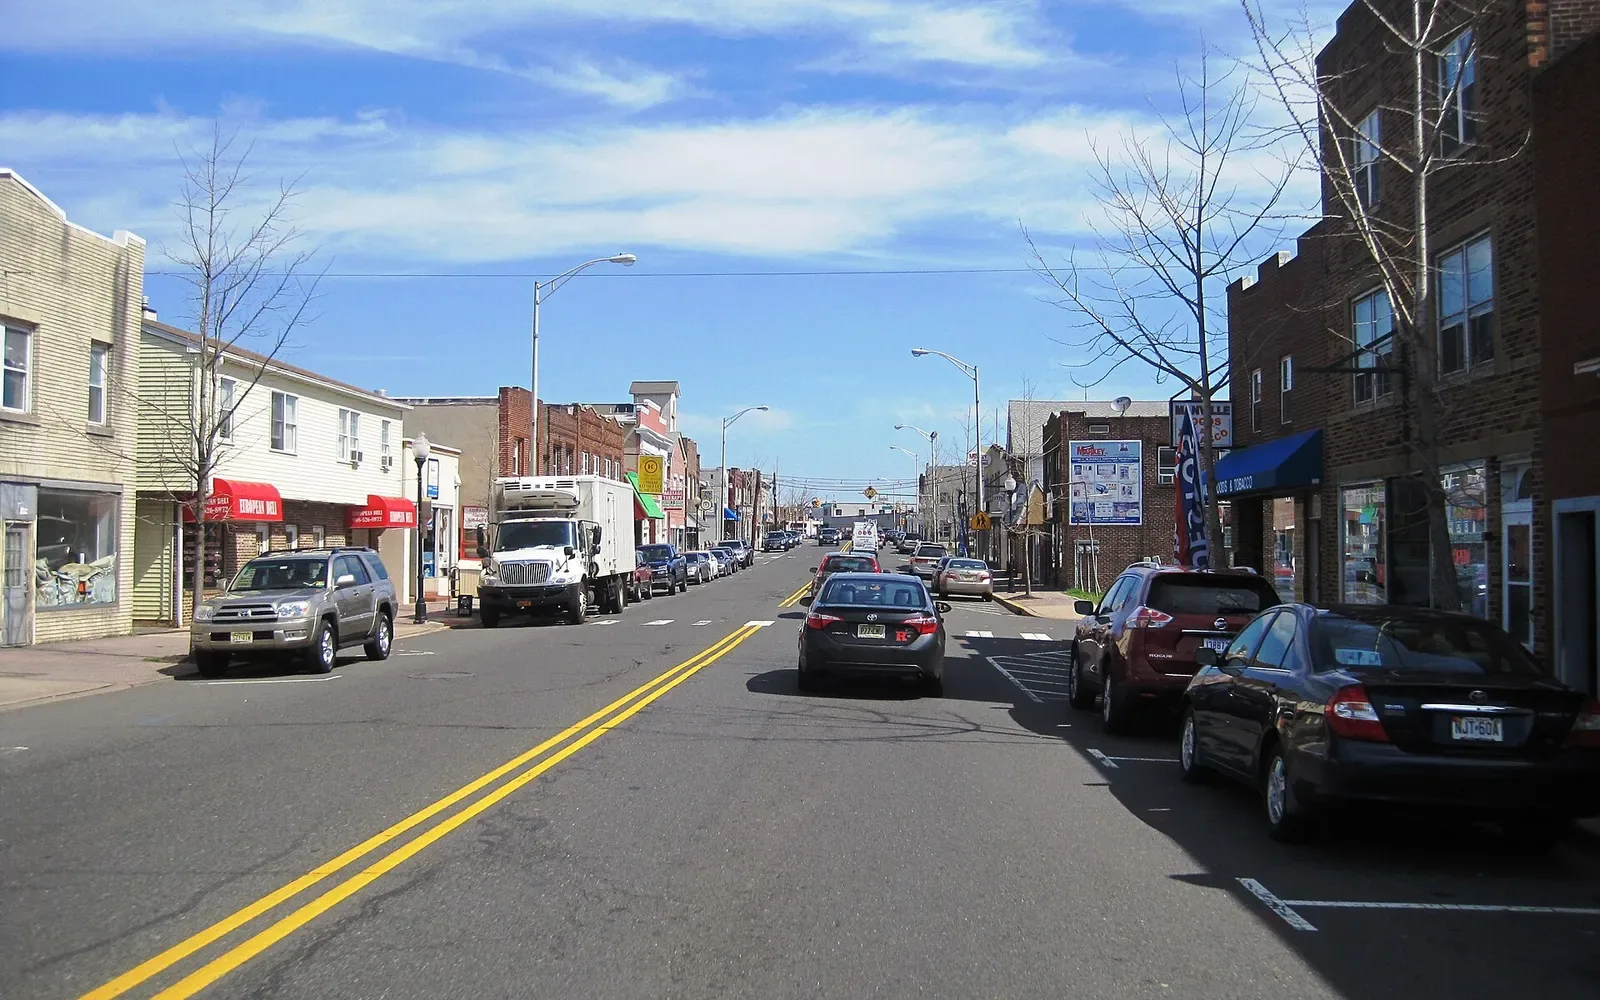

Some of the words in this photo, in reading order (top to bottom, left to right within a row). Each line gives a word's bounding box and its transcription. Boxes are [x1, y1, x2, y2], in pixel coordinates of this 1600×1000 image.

[1229, 479, 1233, 492] &
[1233, 475, 1253, 491] TOBACCO
[217, 497, 229, 505] DELI
[239, 498, 265, 515] EUROPEAN
[266, 500, 277, 515] DELI
[895, 631, 908, 642] R
